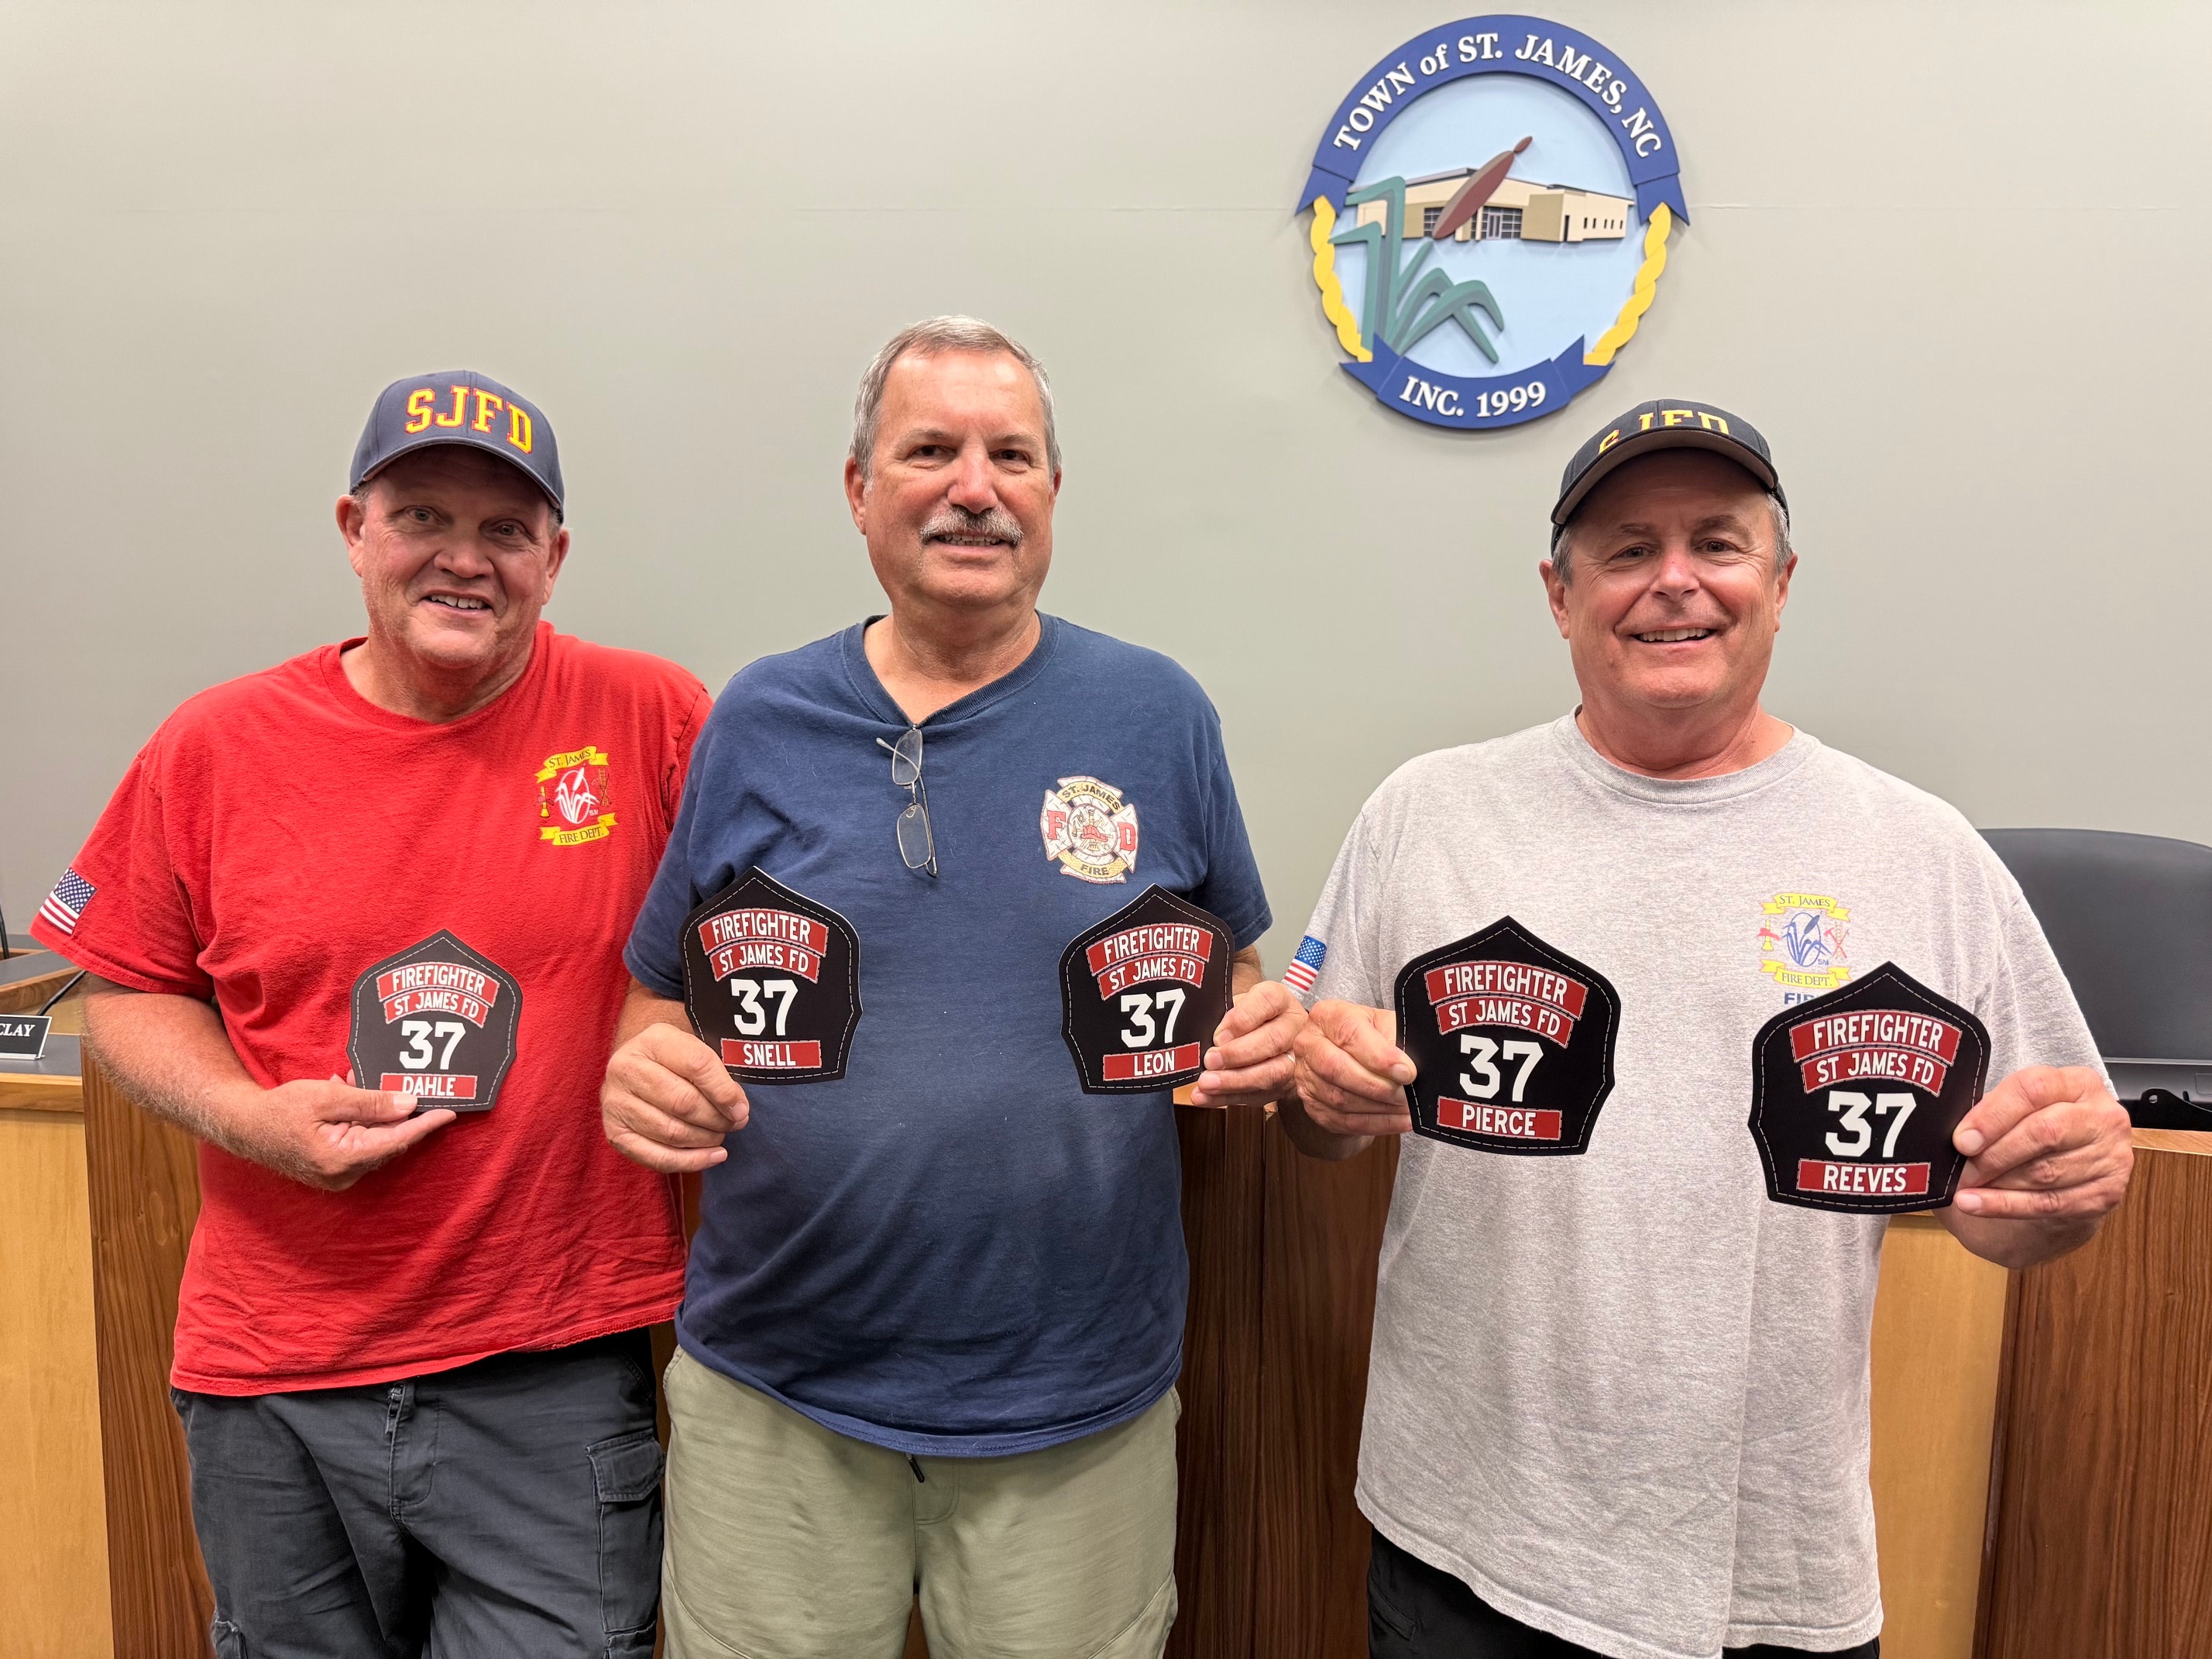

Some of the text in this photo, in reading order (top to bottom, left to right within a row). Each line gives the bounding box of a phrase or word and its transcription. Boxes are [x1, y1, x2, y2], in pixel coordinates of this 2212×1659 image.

[1334, 33, 1662, 158] TOWN of ST. JAMES, NC
[1400, 376, 1547, 417] INC. 1999
[404, 385, 533, 454] SJFD
[548, 749, 591, 768] ST. JAMES
[1061, 785, 1121, 811] ST. JAMES
[558, 826, 604, 843] FIRE DEPT.
[1046, 810, 1136, 851] F D
[1080, 864, 1109, 875] FIRE
[1779, 895, 1830, 907] ST. JAMES
[711, 912, 811, 944] FIREFIGHTER
[719, 944, 809, 973] ST JAMES FD
[1104, 927, 1200, 963] FIREFIGHTER
[393, 965, 486, 996] FIREFIGHTER
[1109, 957, 1196, 990] ST JAMES FD
[1444, 964, 1568, 1005] FIREFIGHTER
[1781, 973, 1832, 986] FIRE DEPT.
[394, 991, 479, 1018] ST JAMES FD
[730, 978, 799, 1036] 37
[1121, 988, 1186, 1048] 37
[1448, 999, 1561, 1036] ST JAMES FD
[399, 1020, 466, 1070] 37
[1813, 1014, 1943, 1052] FIREFIGHTER
[743, 1043, 796, 1066] SNELL
[1133, 1049, 1175, 1077] LEON
[1459, 1033, 1544, 1102] 37
[1816, 1052, 1935, 1084] ST JAMES FD
[402, 1076, 456, 1096] DAHLE
[1462, 1104, 1537, 1136] PIERCE
[1825, 1090, 1917, 1158] 37
[1822, 1165, 1908, 1193] REEVES
